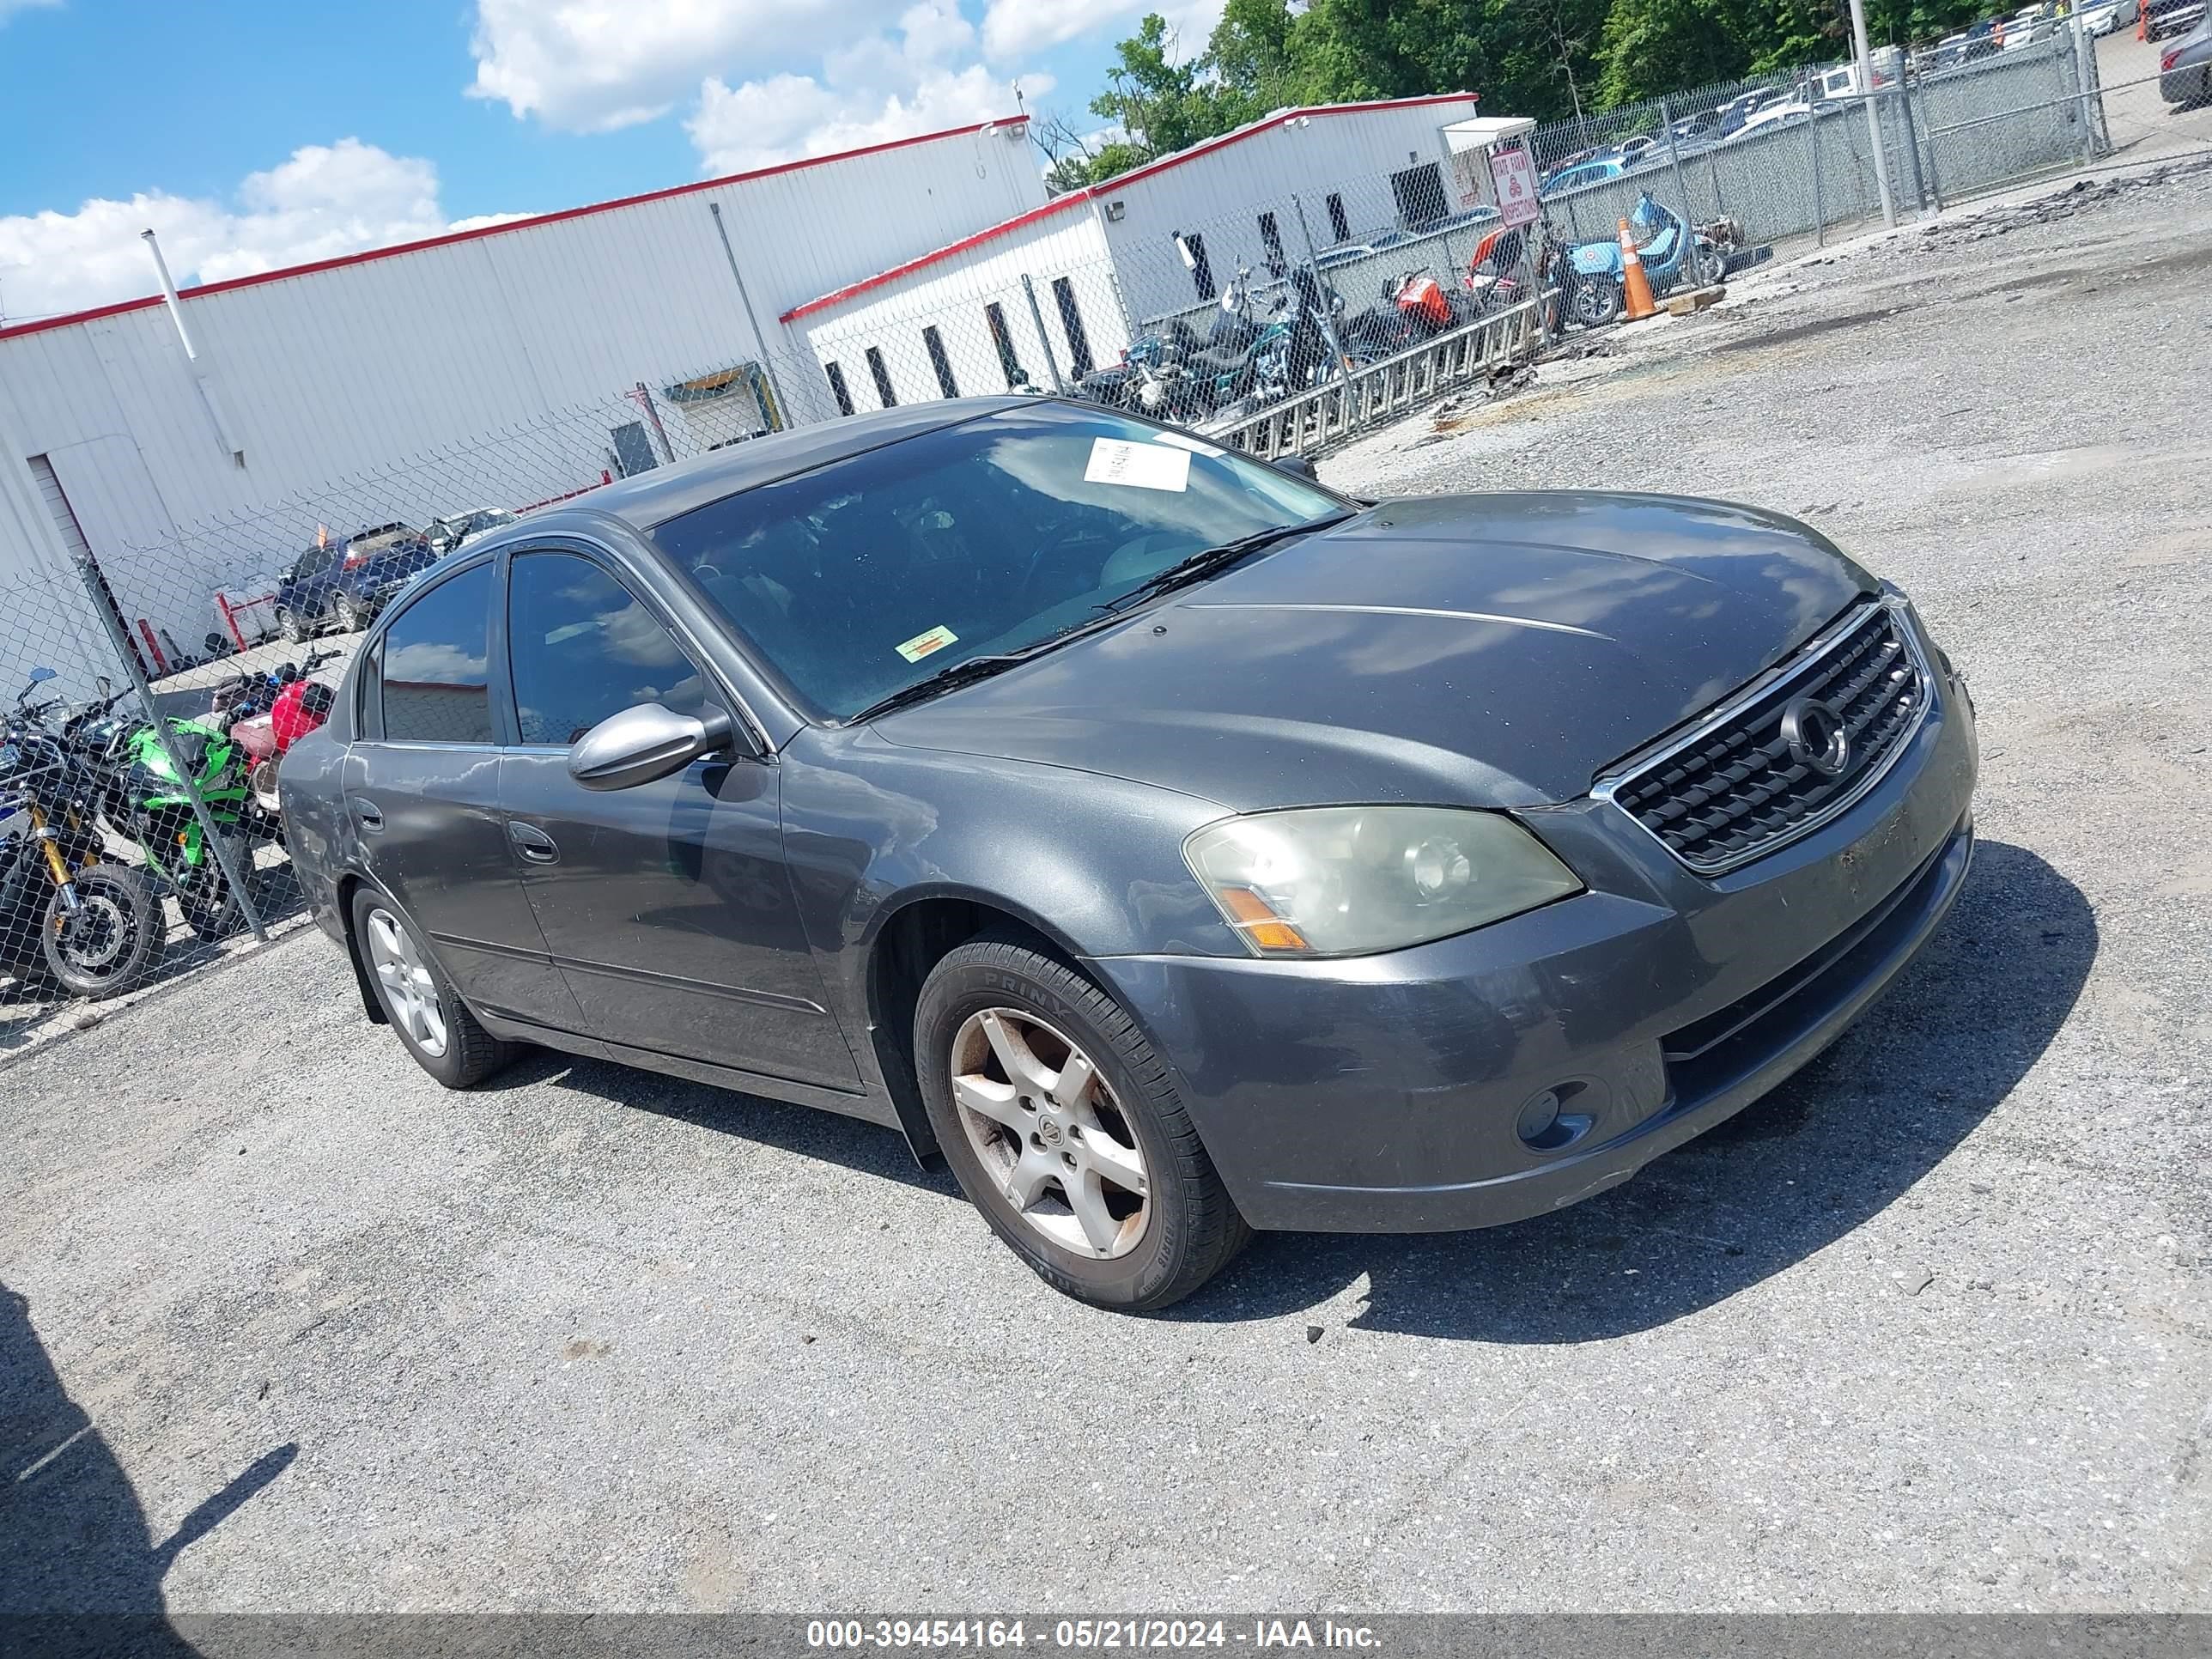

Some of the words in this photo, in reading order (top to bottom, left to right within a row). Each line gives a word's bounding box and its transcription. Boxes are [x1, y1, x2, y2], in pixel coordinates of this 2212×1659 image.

[1493, 158, 1510, 178] STATE
[1510, 155, 1527, 173] FARM
[984, 972, 1072, 1018] PRINX
